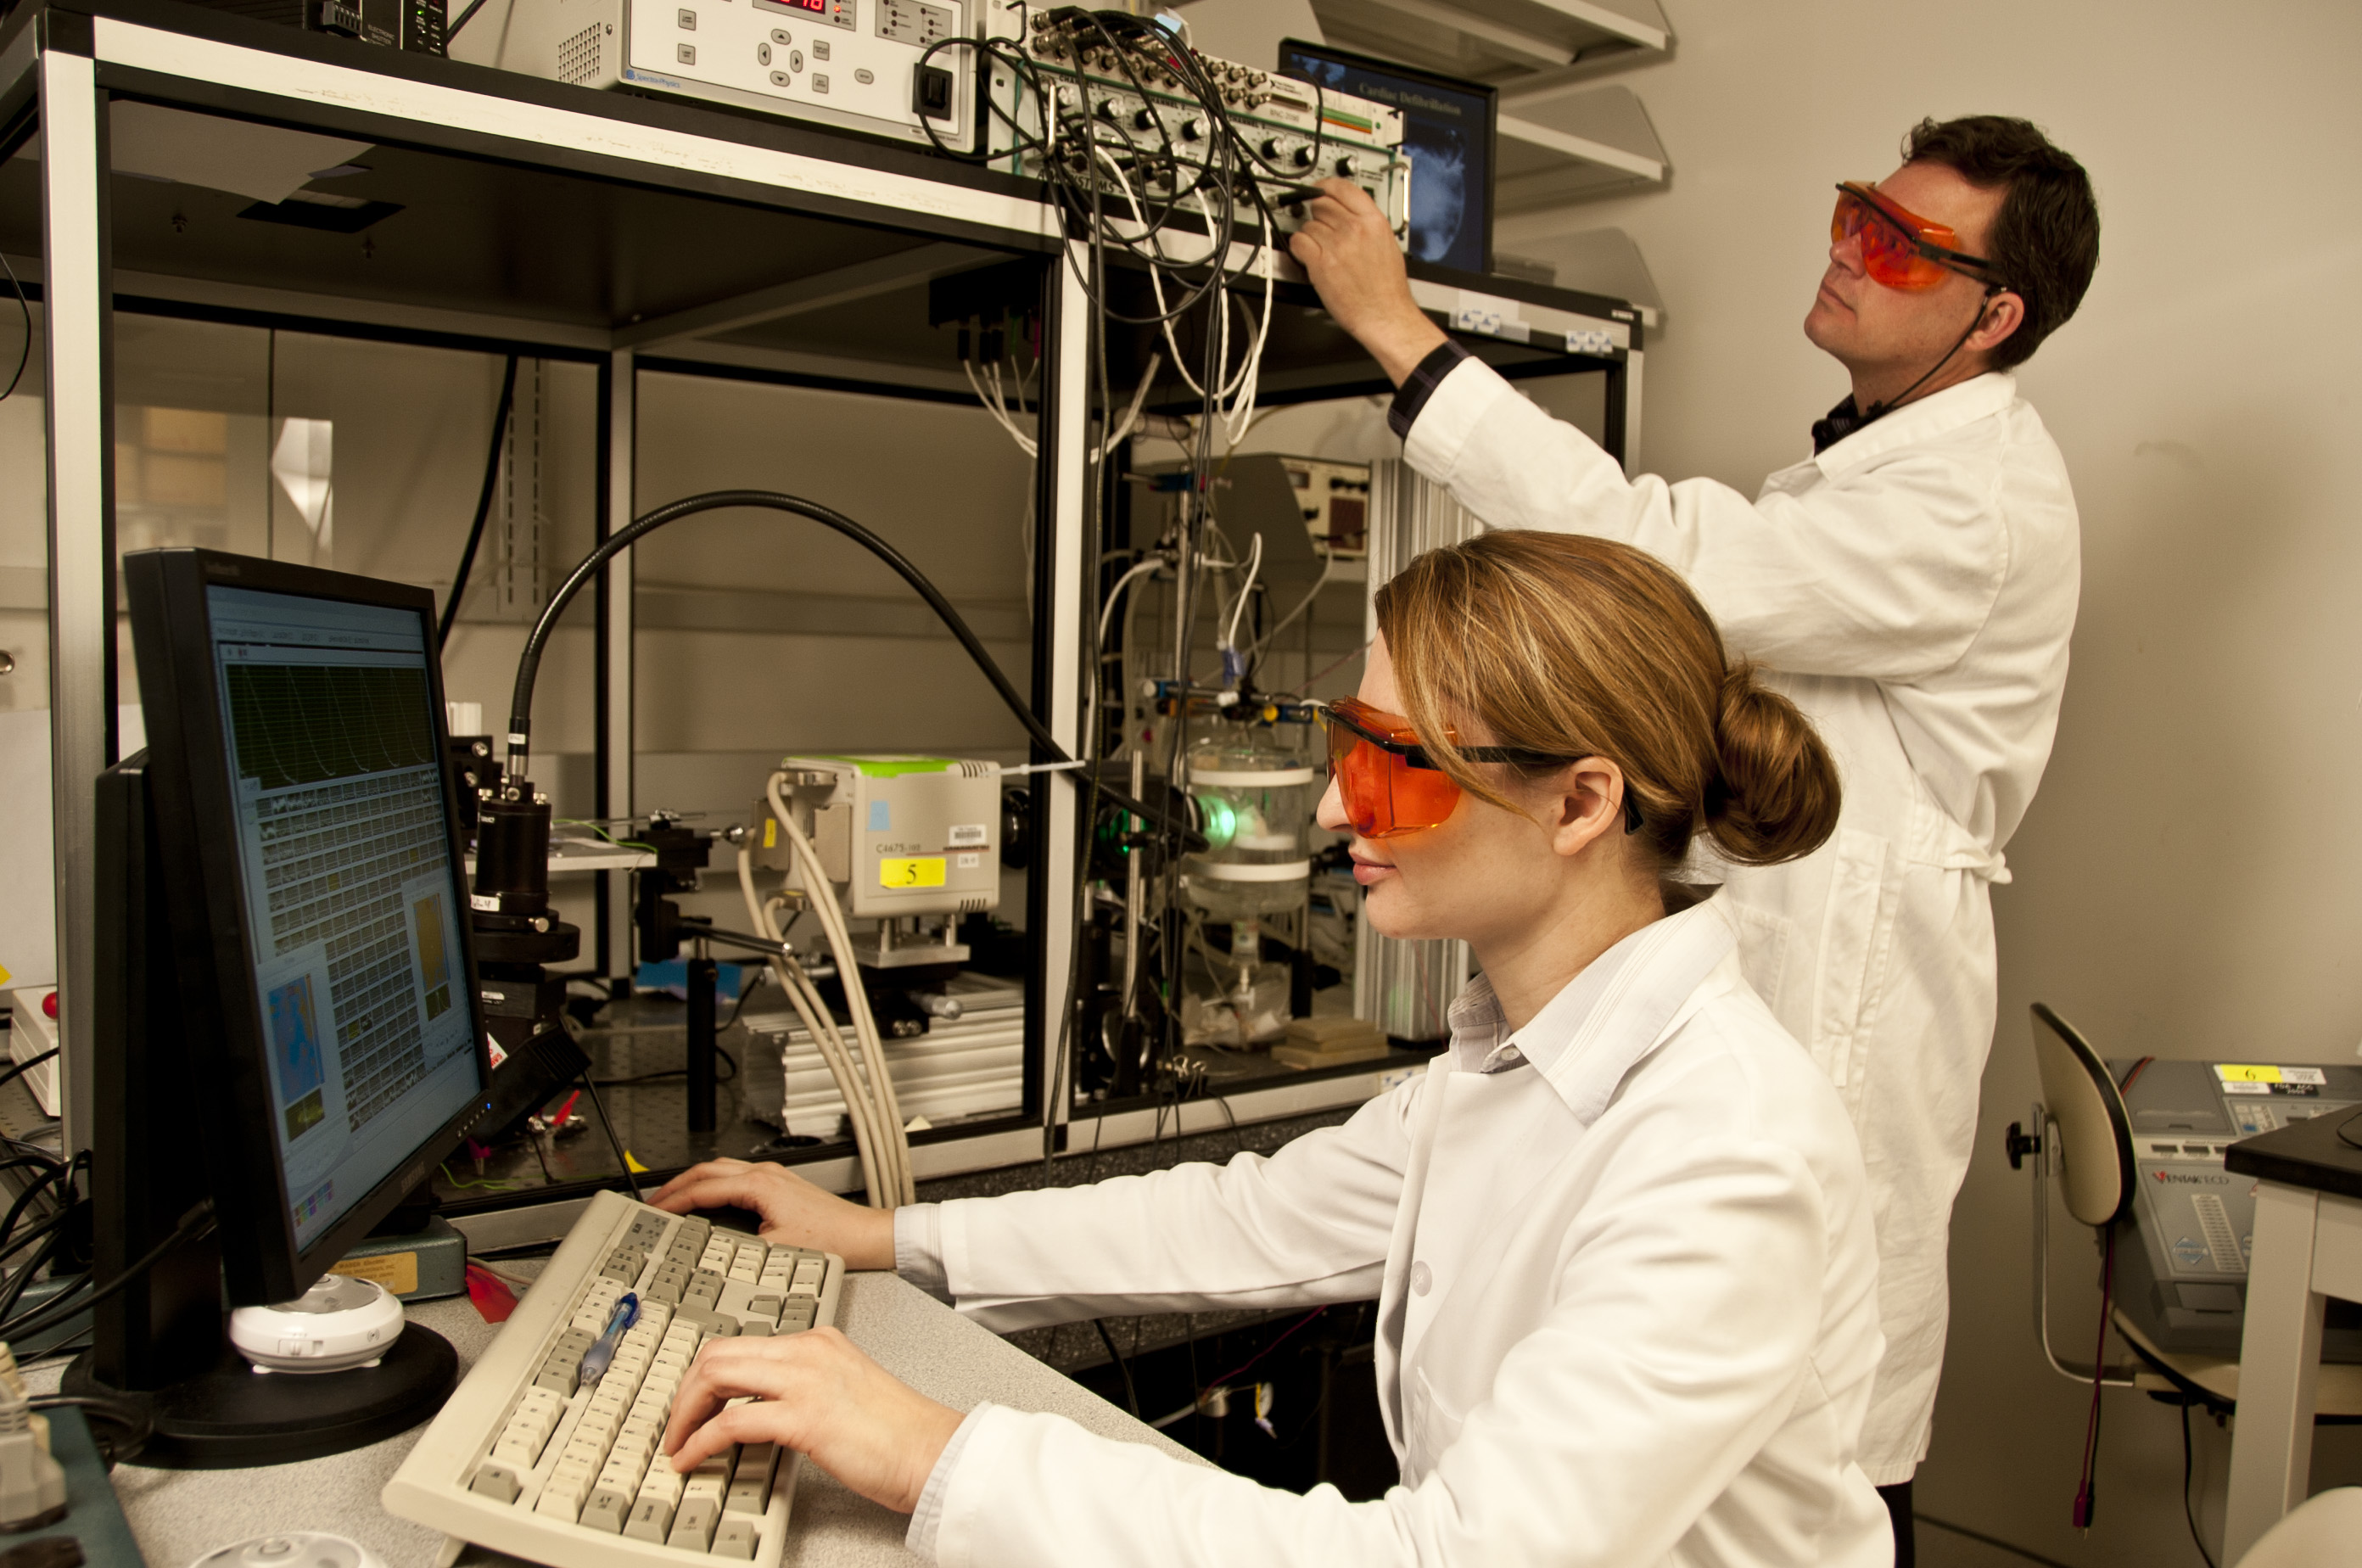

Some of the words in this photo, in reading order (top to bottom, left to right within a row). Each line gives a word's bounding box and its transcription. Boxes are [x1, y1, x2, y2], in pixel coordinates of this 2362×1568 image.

[635, 73, 680, 88] Spectra-Physics
[1359, 82, 1397, 102] Cardiac
[1400, 92, 1462, 117] Defibrillation
[905, 863, 916, 885] 5
[2244, 1067, 2257, 1082] 6
[400, 1160, 425, 1196] SAMSUNG
